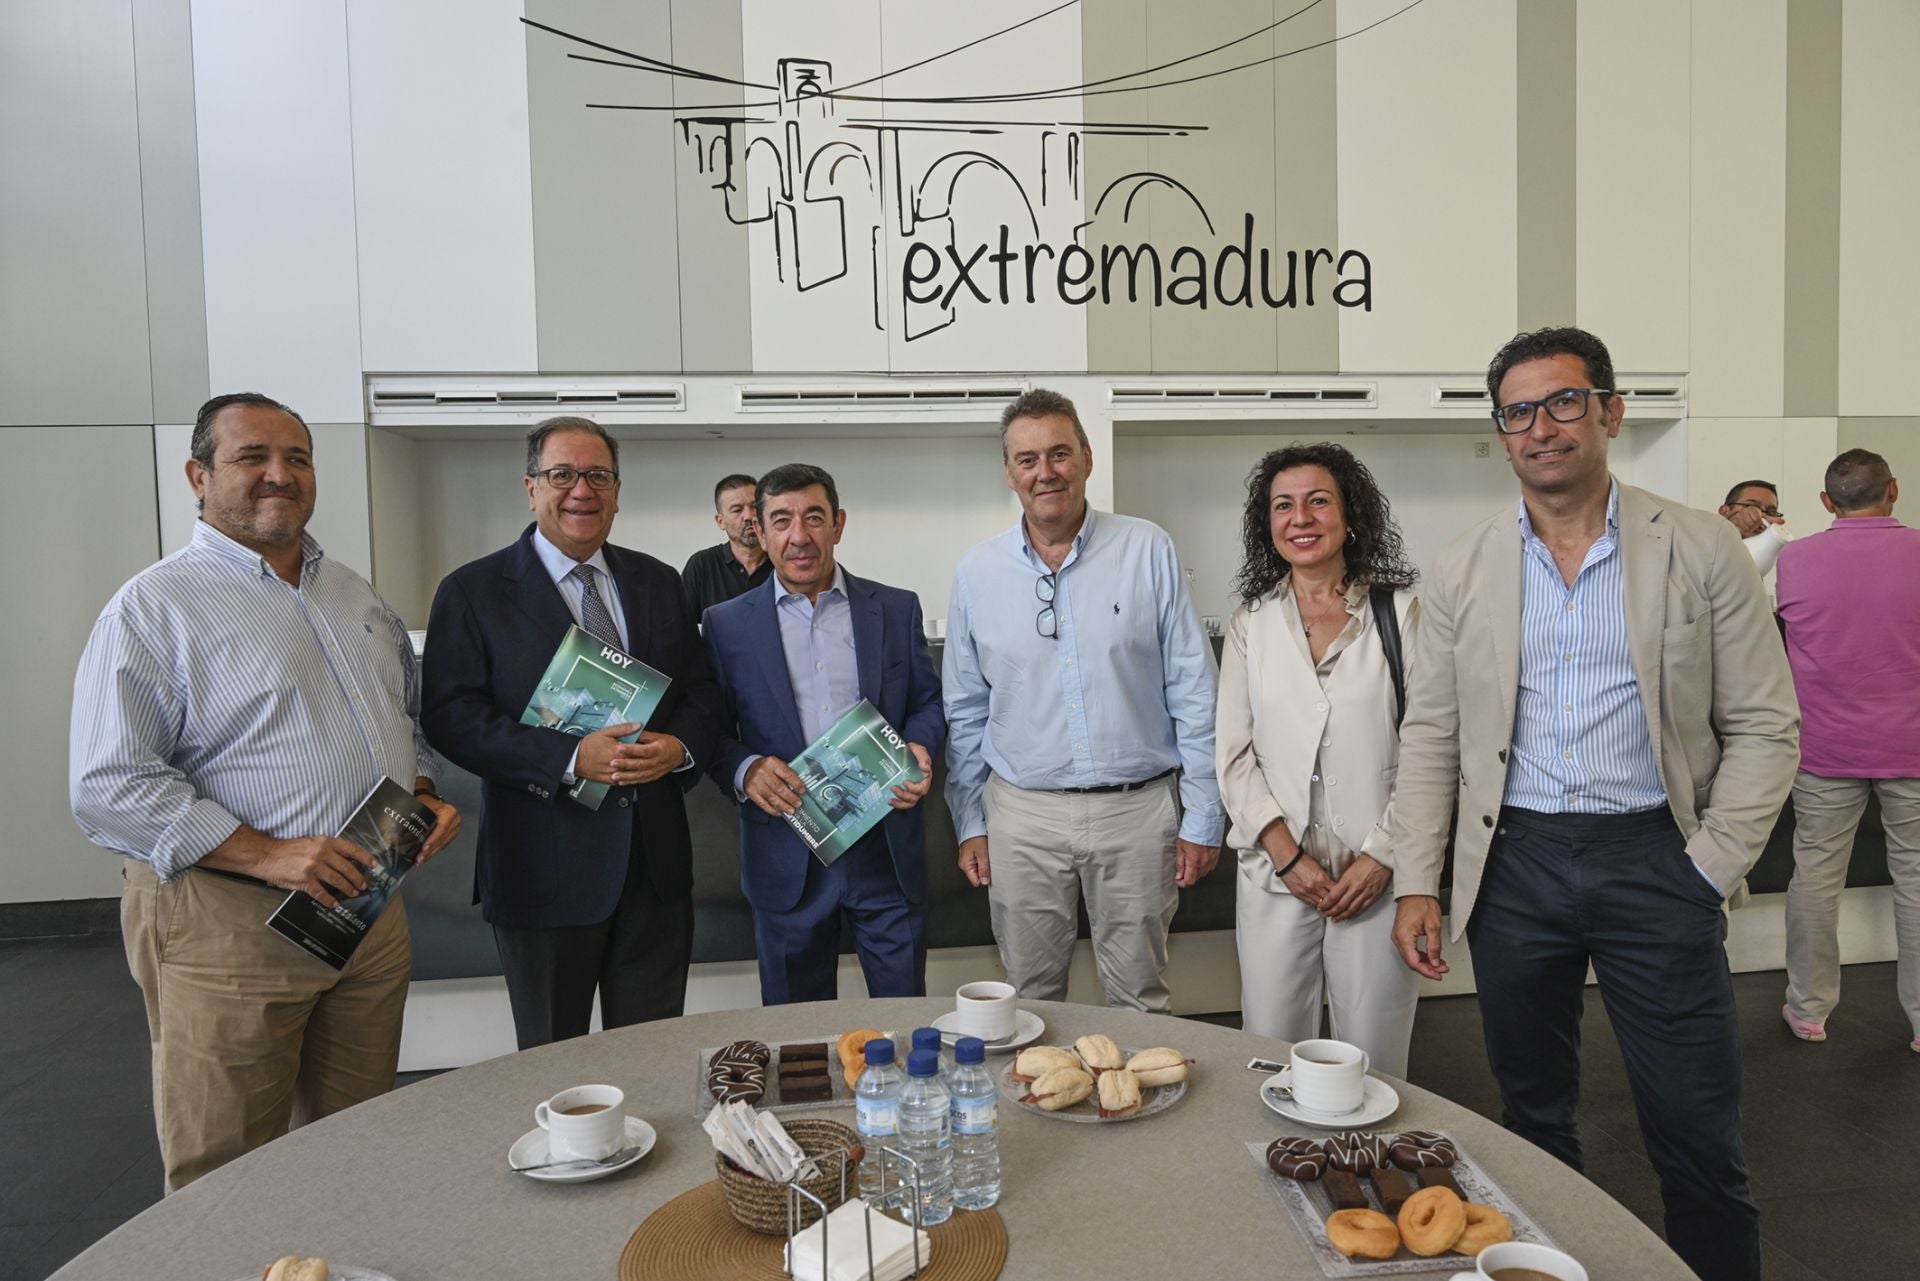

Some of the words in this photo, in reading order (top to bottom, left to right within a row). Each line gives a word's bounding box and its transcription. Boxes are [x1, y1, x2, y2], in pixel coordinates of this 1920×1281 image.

[902, 212, 1372, 312] extremadura
[600, 647, 633, 669] HOY
[880, 725, 906, 750] HOY
[783, 811, 819, 849] TIDUMBRE
